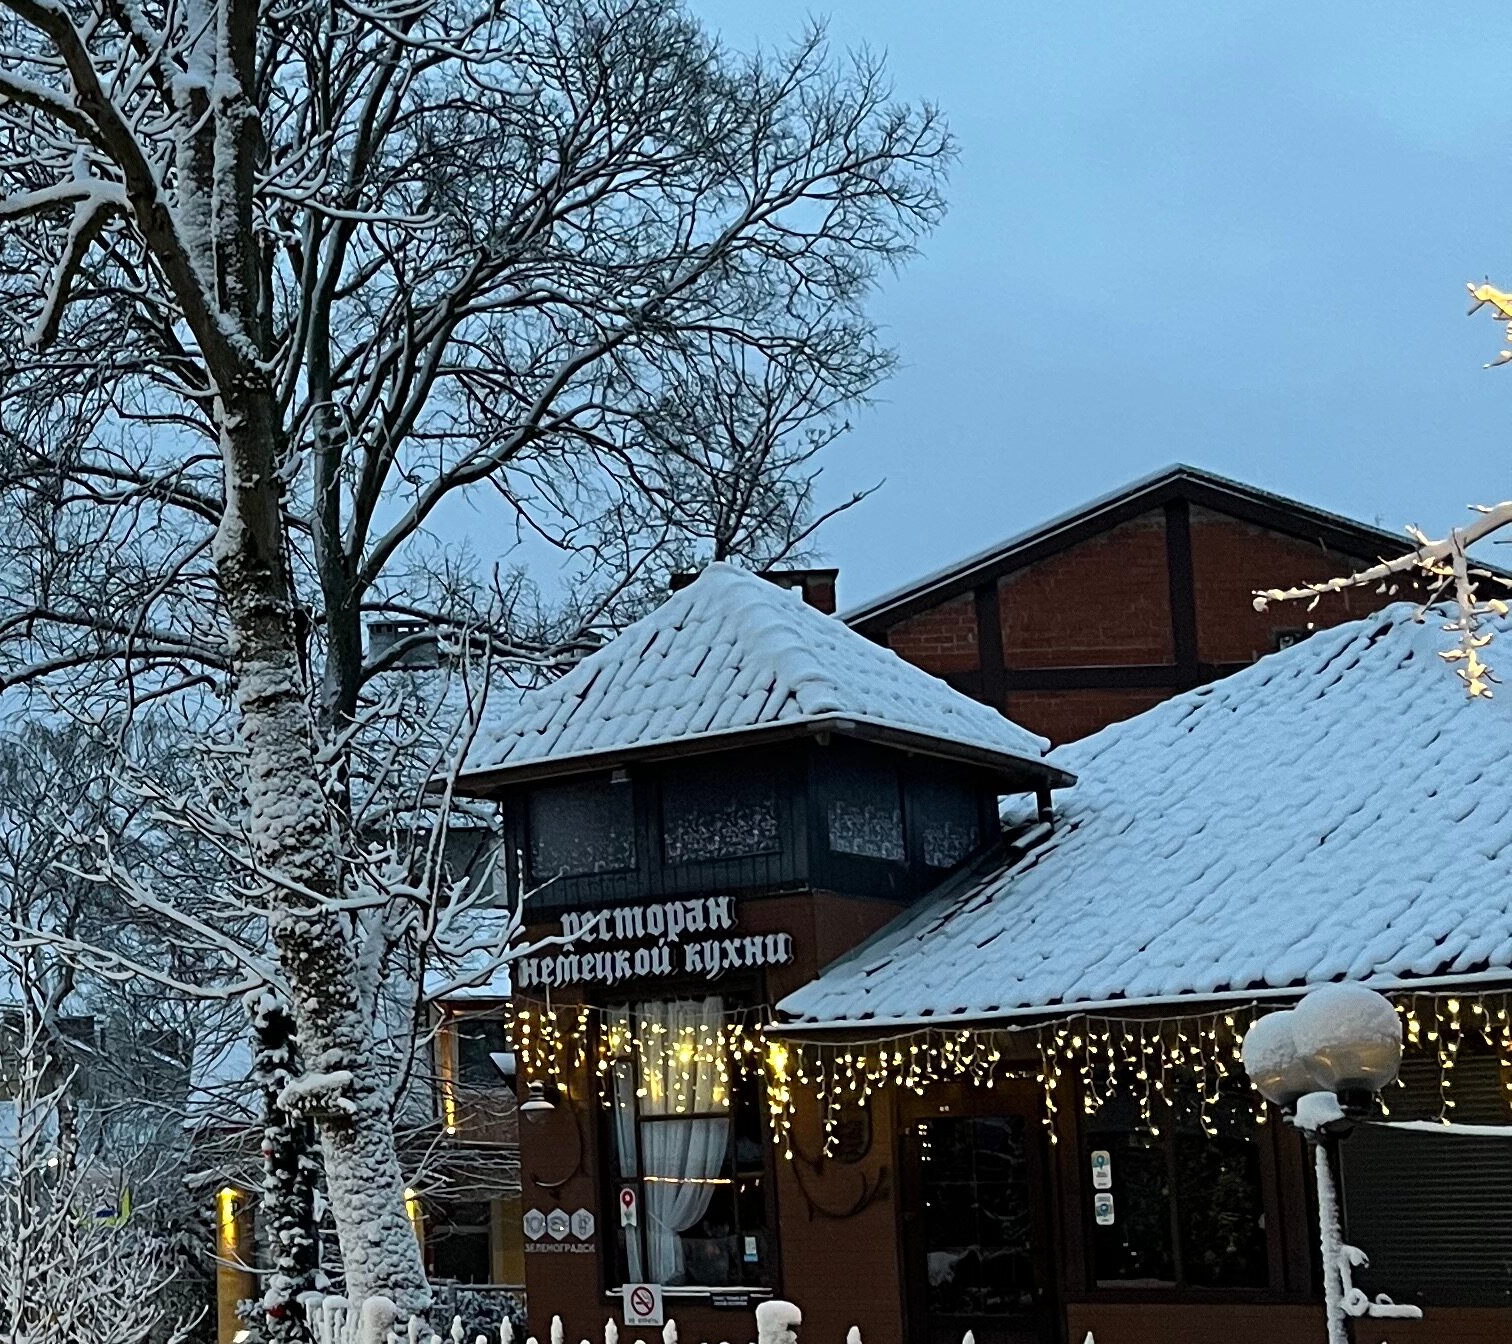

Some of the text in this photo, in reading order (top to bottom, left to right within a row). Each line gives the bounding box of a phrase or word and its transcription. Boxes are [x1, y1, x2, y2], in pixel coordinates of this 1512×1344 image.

[560, 895, 733, 951] ресторан
[518, 932, 792, 987] немецкой кухни
